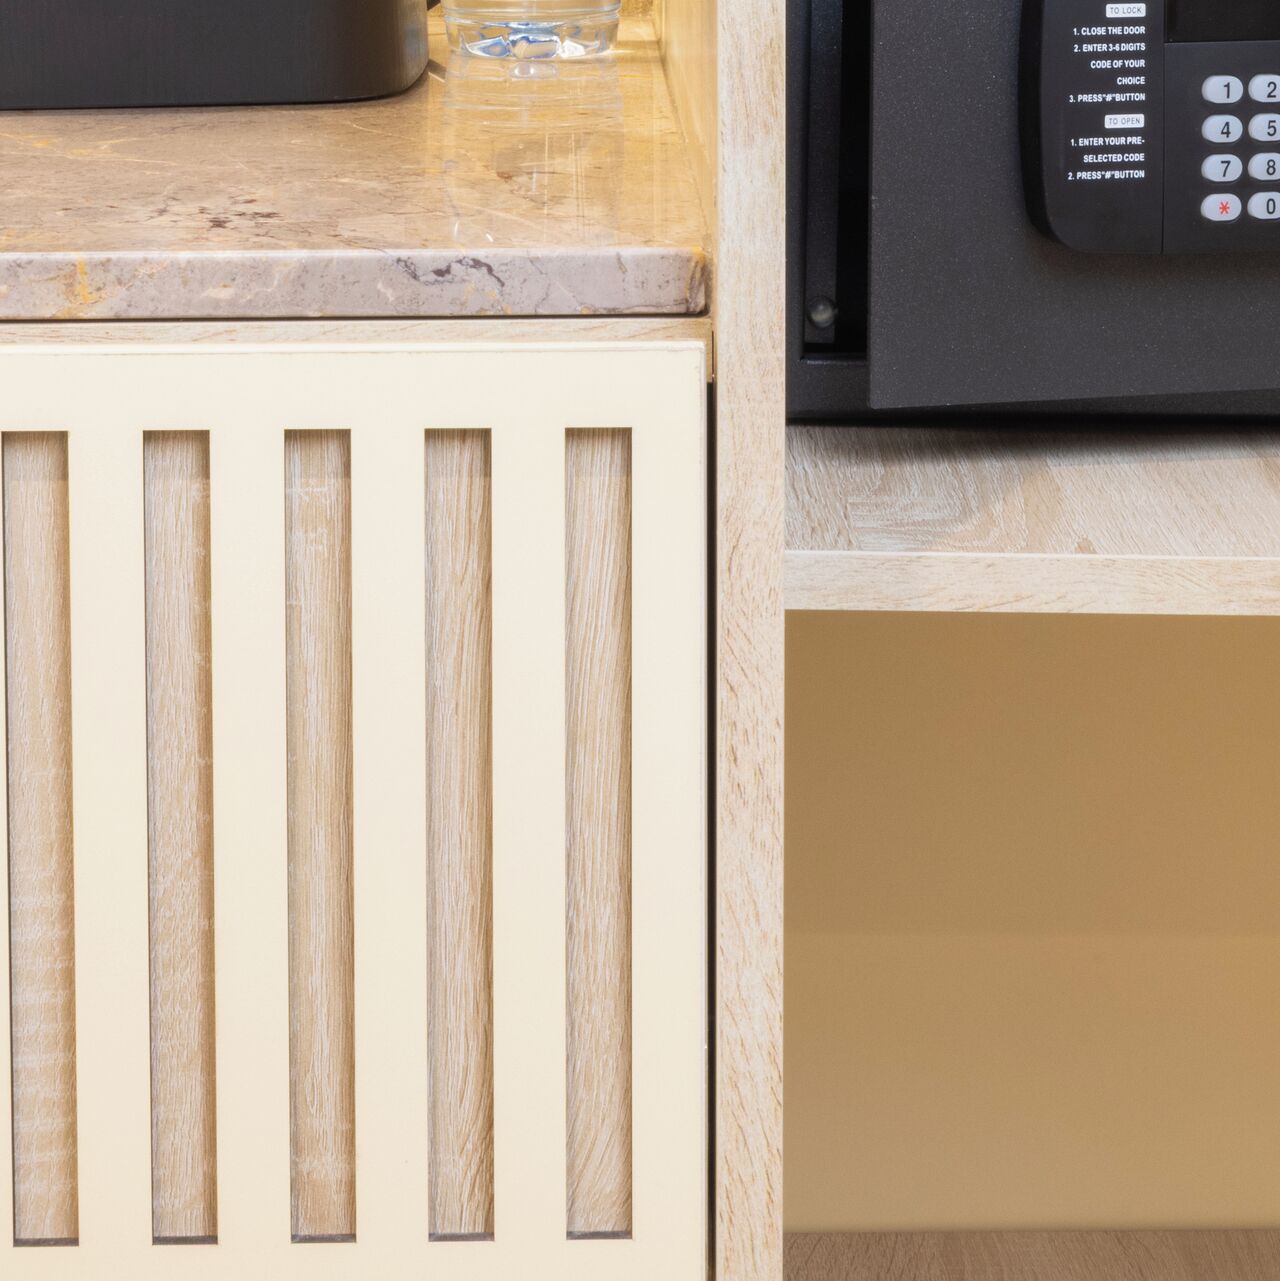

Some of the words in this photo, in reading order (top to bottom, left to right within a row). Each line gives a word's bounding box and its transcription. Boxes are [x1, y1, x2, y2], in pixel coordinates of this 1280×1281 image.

[1110, 6, 1119, 14] TO
[1122, 6, 1141, 14] LOCK
[1081, 27, 1106, 35] CLOSE
[1108, 26, 1122, 34] THE
[1124, 26, 1145, 34] DOOR
[1083, 43, 1107, 51] ENTER
[1109, 43, 1119, 51] 3-6
[1090, 60, 1111, 68] CODE
[1124, 59, 1144, 67] YOUR
[1117, 76, 1145, 84] CHOICE
[1223, 82, 1229, 98] 1
[1267, 81, 1276, 98] 2
[1220, 121, 1230, 138] 4
[1267, 120, 1276, 136] 5
[1079, 137, 1103, 145] ENTER
[1104, 137, 1125, 145] YOUR
[1127, 136, 1144, 144] PRE-
[1083, 154, 1122, 162] SELECTED
[1123, 153, 1144, 161] CODE
[1220, 160, 1230, 177] 7
[1266, 159, 1275, 175] 8
[1266, 198, 1275, 214] 0
